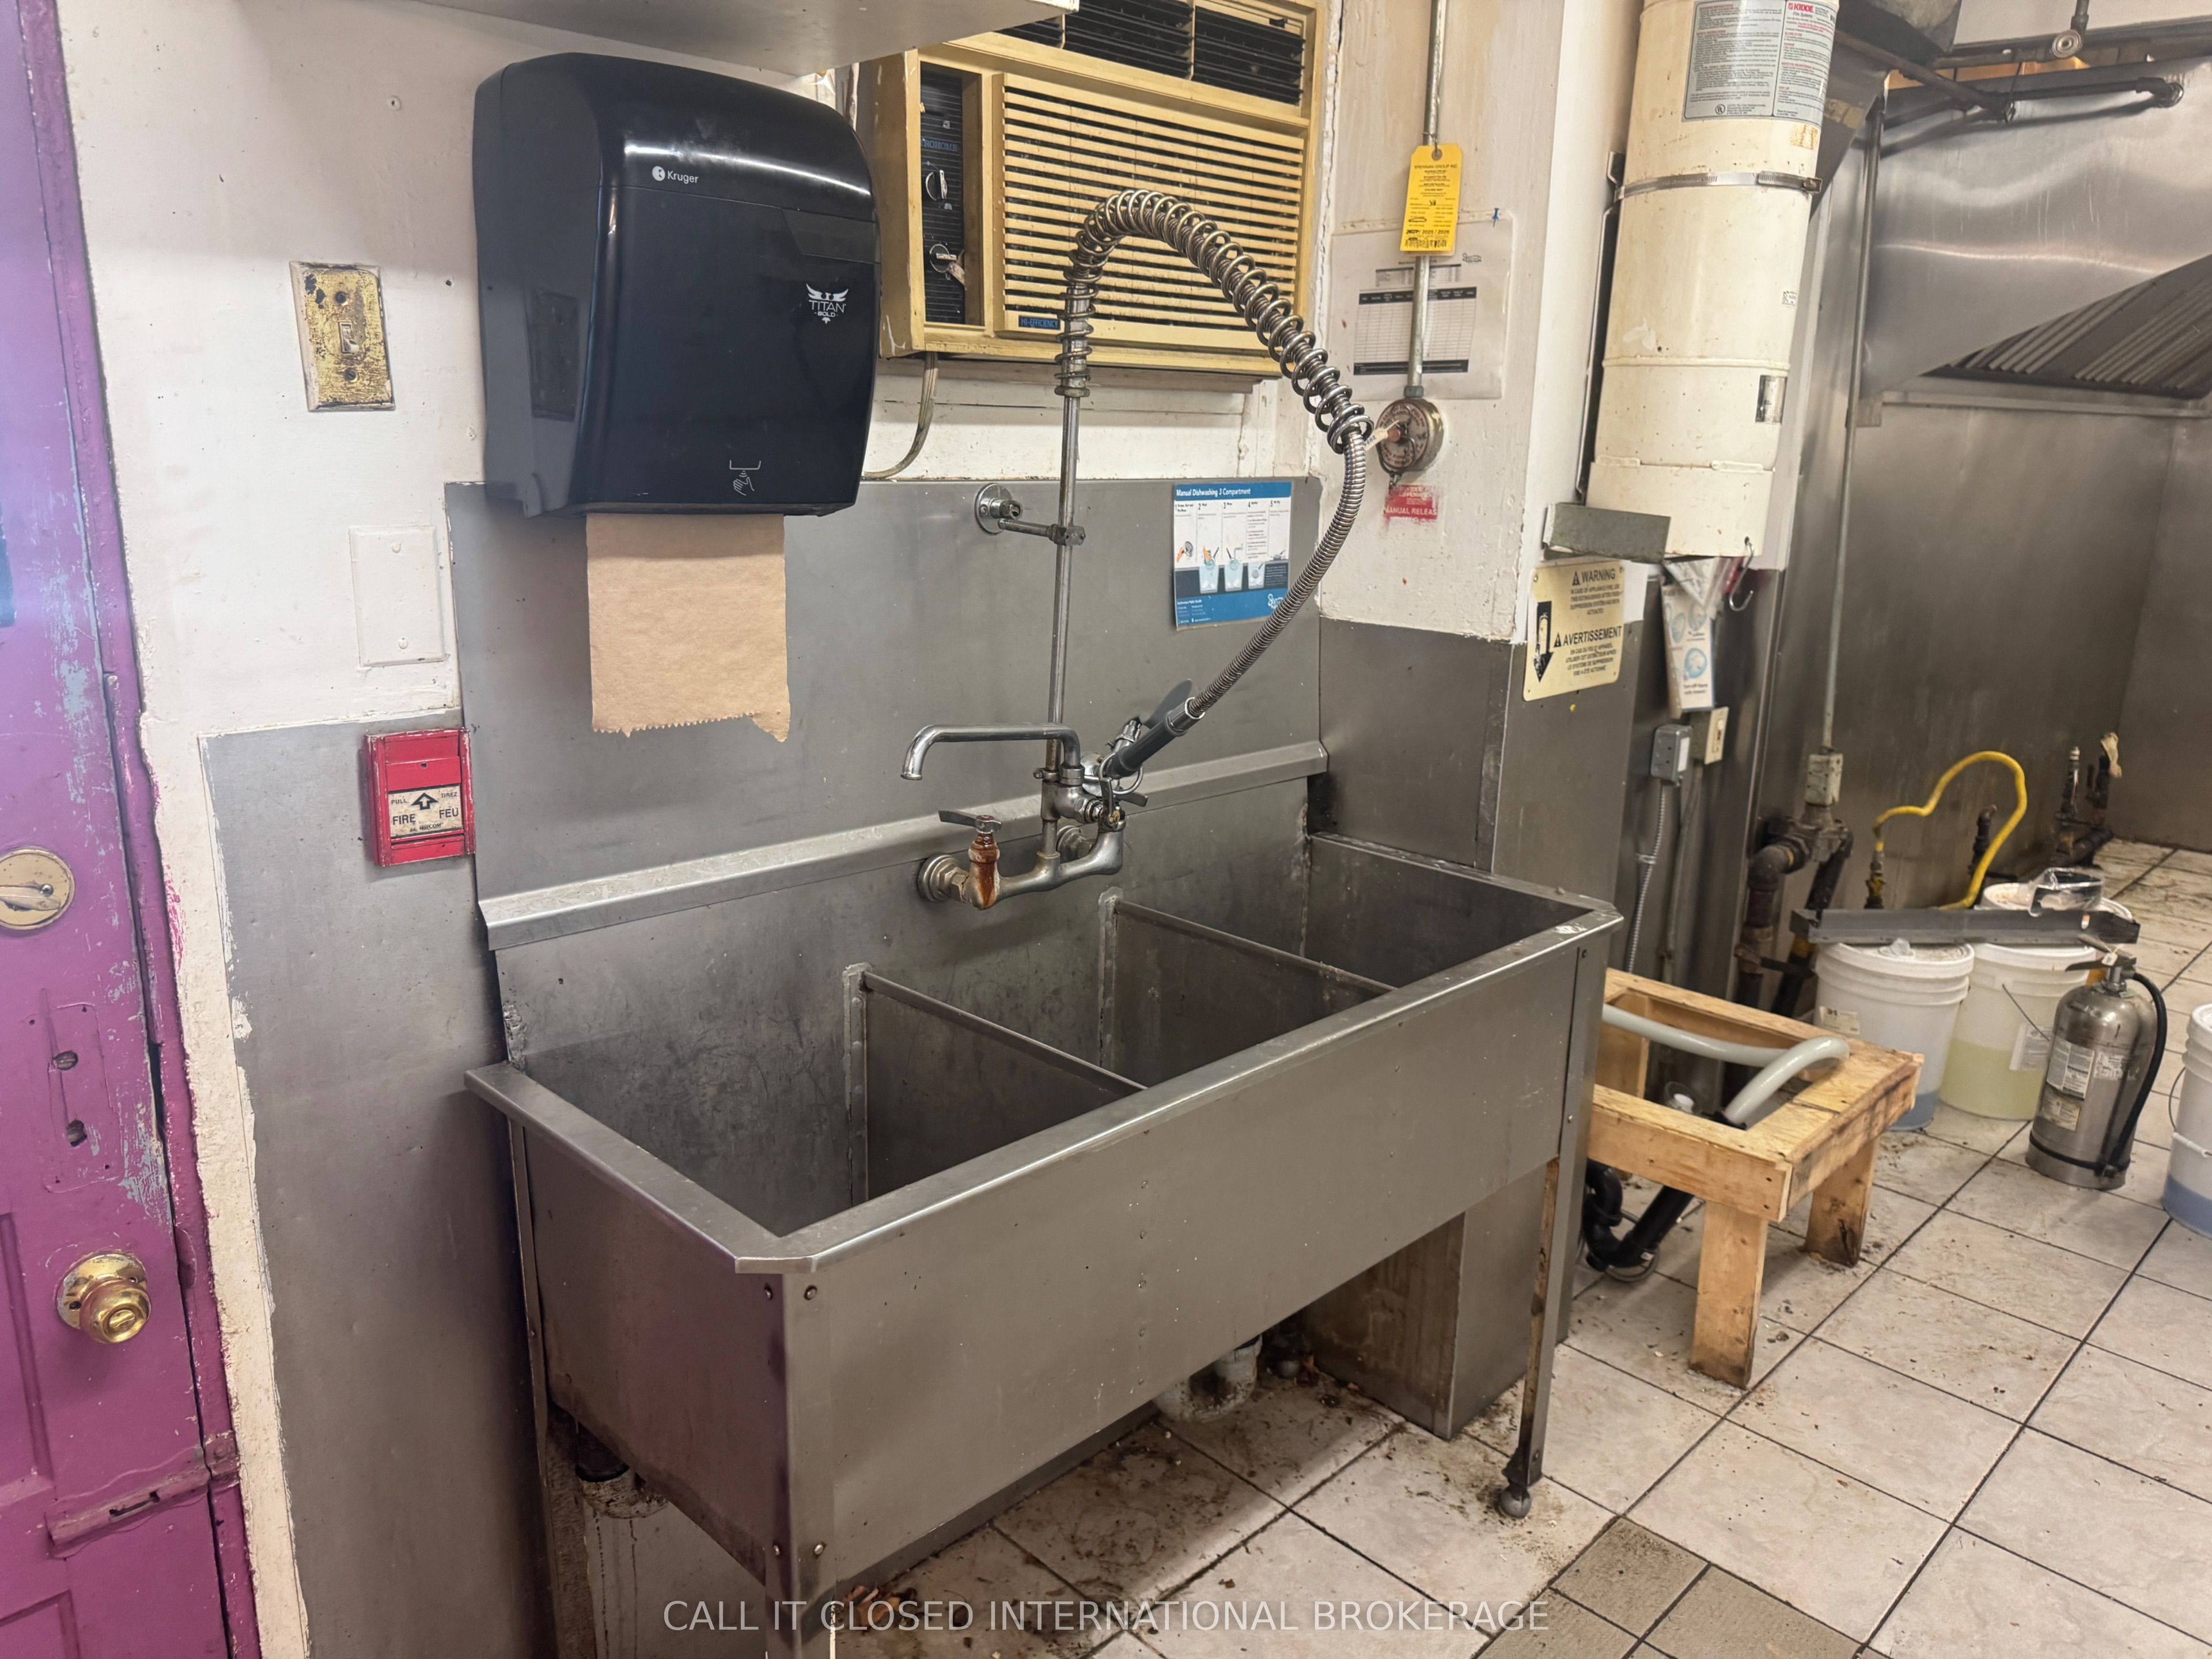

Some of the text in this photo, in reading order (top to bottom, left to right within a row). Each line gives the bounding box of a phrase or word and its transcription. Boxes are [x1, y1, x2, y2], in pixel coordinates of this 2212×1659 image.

[1794, 3, 1814, 13] KIDDE
[667, 171, 699, 184] Kruger
[808, 300, 845, 313] TITAN
[1021, 317, 1058, 328] HI-EFFICIENCY
[1192, 487, 1218, 498] Dishwashing
[1223, 487, 1251, 496] Compartment
[1581, 569, 1615, 582] WARNING
[1563, 626, 1622, 646] AVERTISSEMENT
[392, 813, 416, 825] FIRE
[439, 807, 459, 819] FEU
